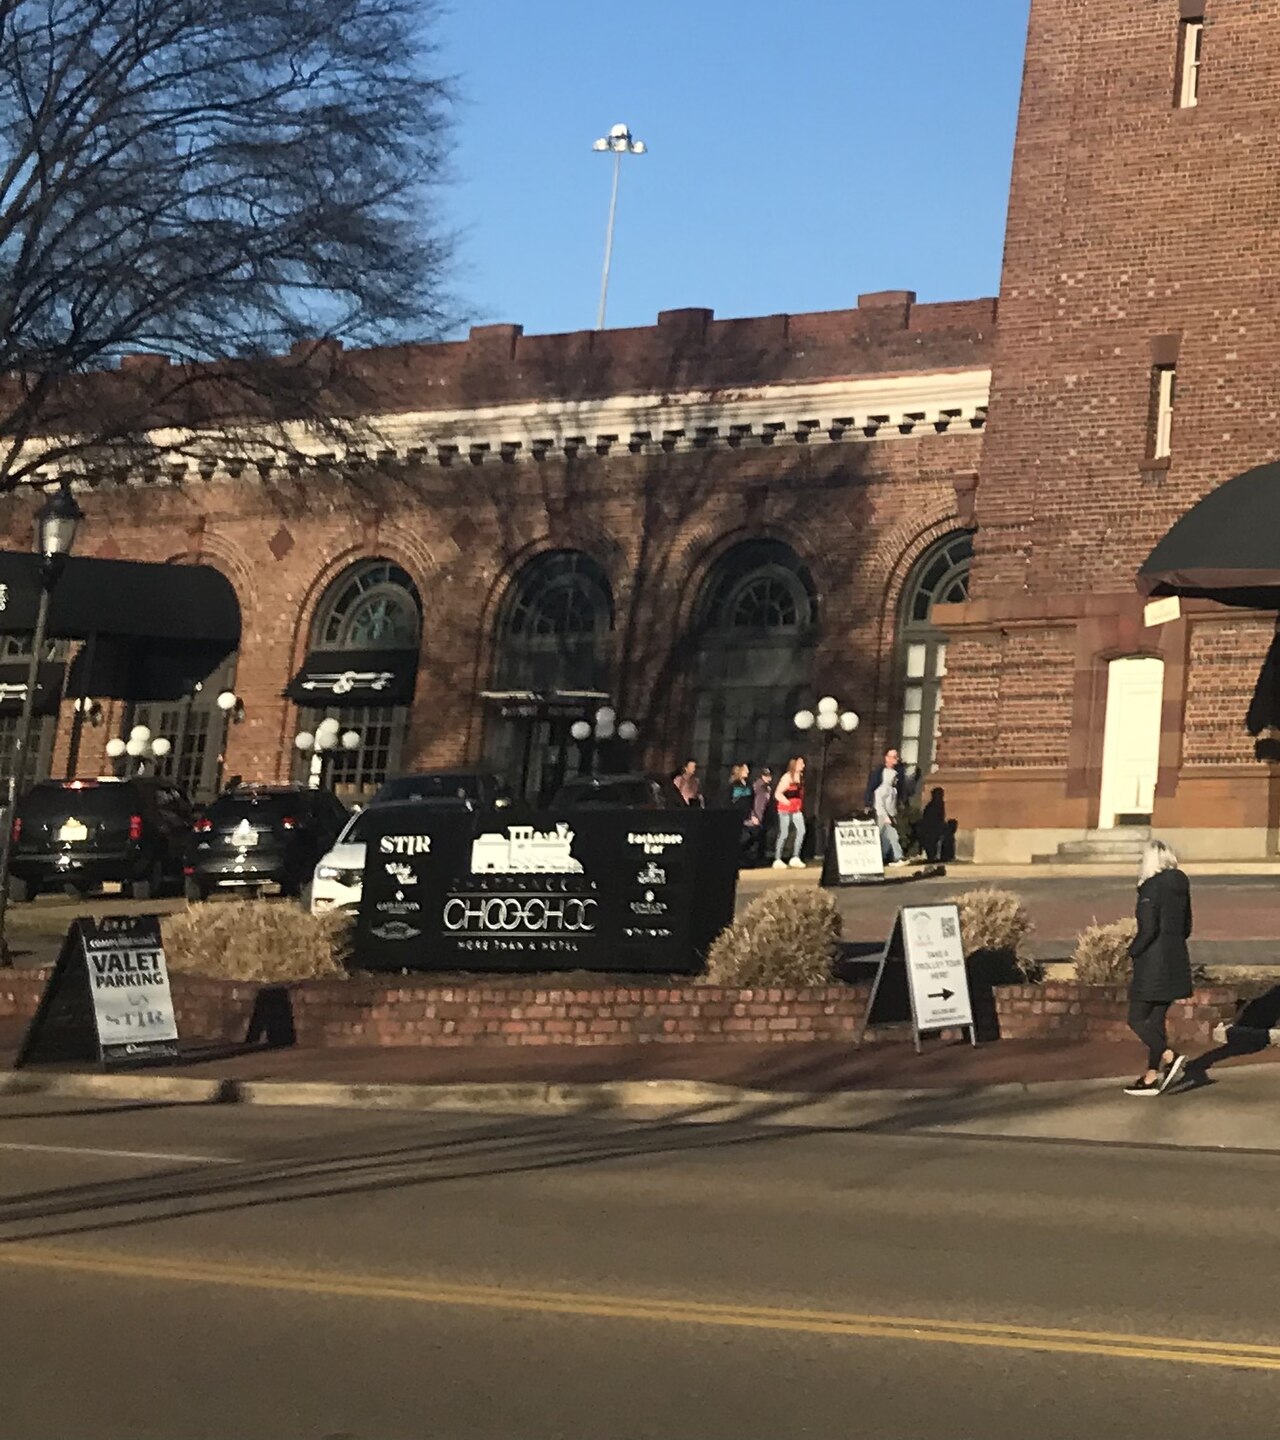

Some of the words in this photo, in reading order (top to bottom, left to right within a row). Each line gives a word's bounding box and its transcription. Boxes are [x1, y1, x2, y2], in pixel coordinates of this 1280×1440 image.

[839, 829, 875, 838] VALET
[380, 835, 431, 855] STIR
[91, 952, 161, 973] VALET
[95, 972, 164, 989] PARKING
